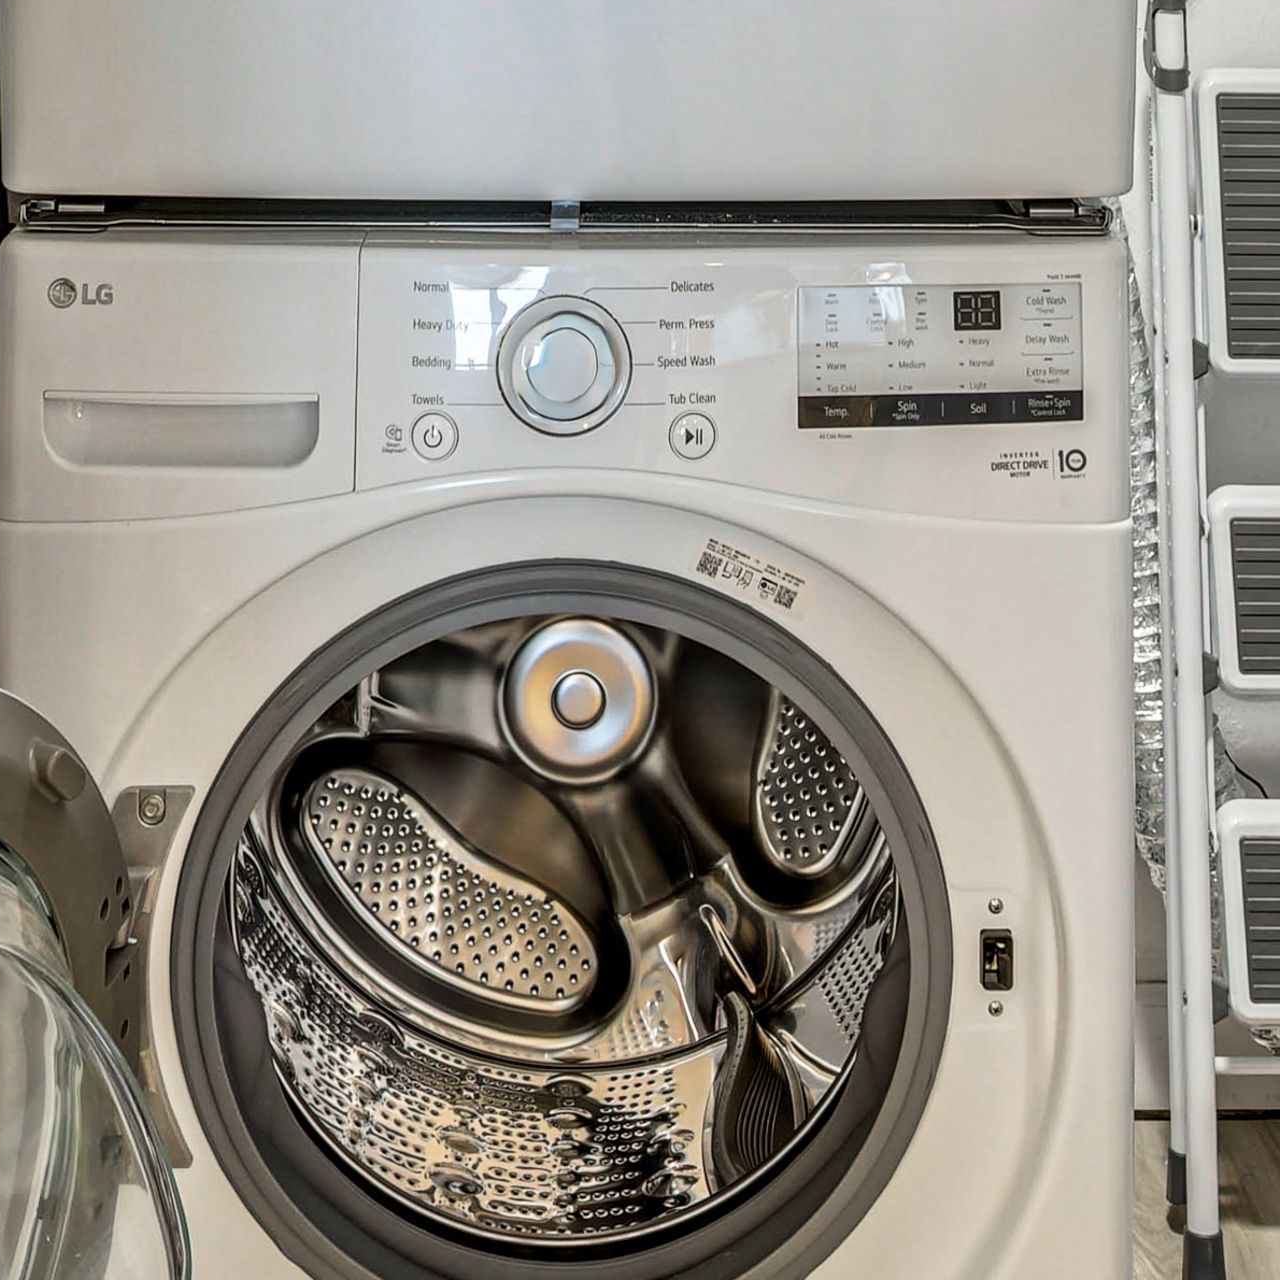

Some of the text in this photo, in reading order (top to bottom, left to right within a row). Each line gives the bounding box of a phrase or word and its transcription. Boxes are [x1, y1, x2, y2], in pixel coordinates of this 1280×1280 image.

[413, 281, 450, 293] Normal
[670, 281, 715, 293] Delicates
[81, 283, 114, 305] LG
[1025, 296, 1067, 306] Cold Wash
[412, 318, 469, 333] Heavy Duty
[659, 318, 715, 331] Perm. Press
[825, 340, 839, 349] Hot
[897, 338, 915, 349] High
[968, 336, 991, 347] Heavy
[1025, 334, 1070, 345] Delay Wash
[412, 356, 452, 370] Bedding
[657, 355, 716, 370] Speed Wash
[826, 362, 847, 371] Warm
[898, 360, 927, 370] Medium
[968, 359, 995, 368] Normal
[1026, 366, 1070, 377] Extra Rinse
[827, 384, 857, 394] Tap Cold
[898, 383, 913, 392] Low
[969, 380, 988, 390] Light
[412, 393, 445, 405] Towels
[669, 392, 716, 404] Tub Clean
[823, 406, 849, 418] Temp.
[897, 400, 918, 412] Spin
[969, 402, 987, 414] Soil
[999, 451, 1040, 459] INVERTER
[1058, 449, 1087, 473] 10
[990, 460, 1049, 472] DIRECT DRIVE
